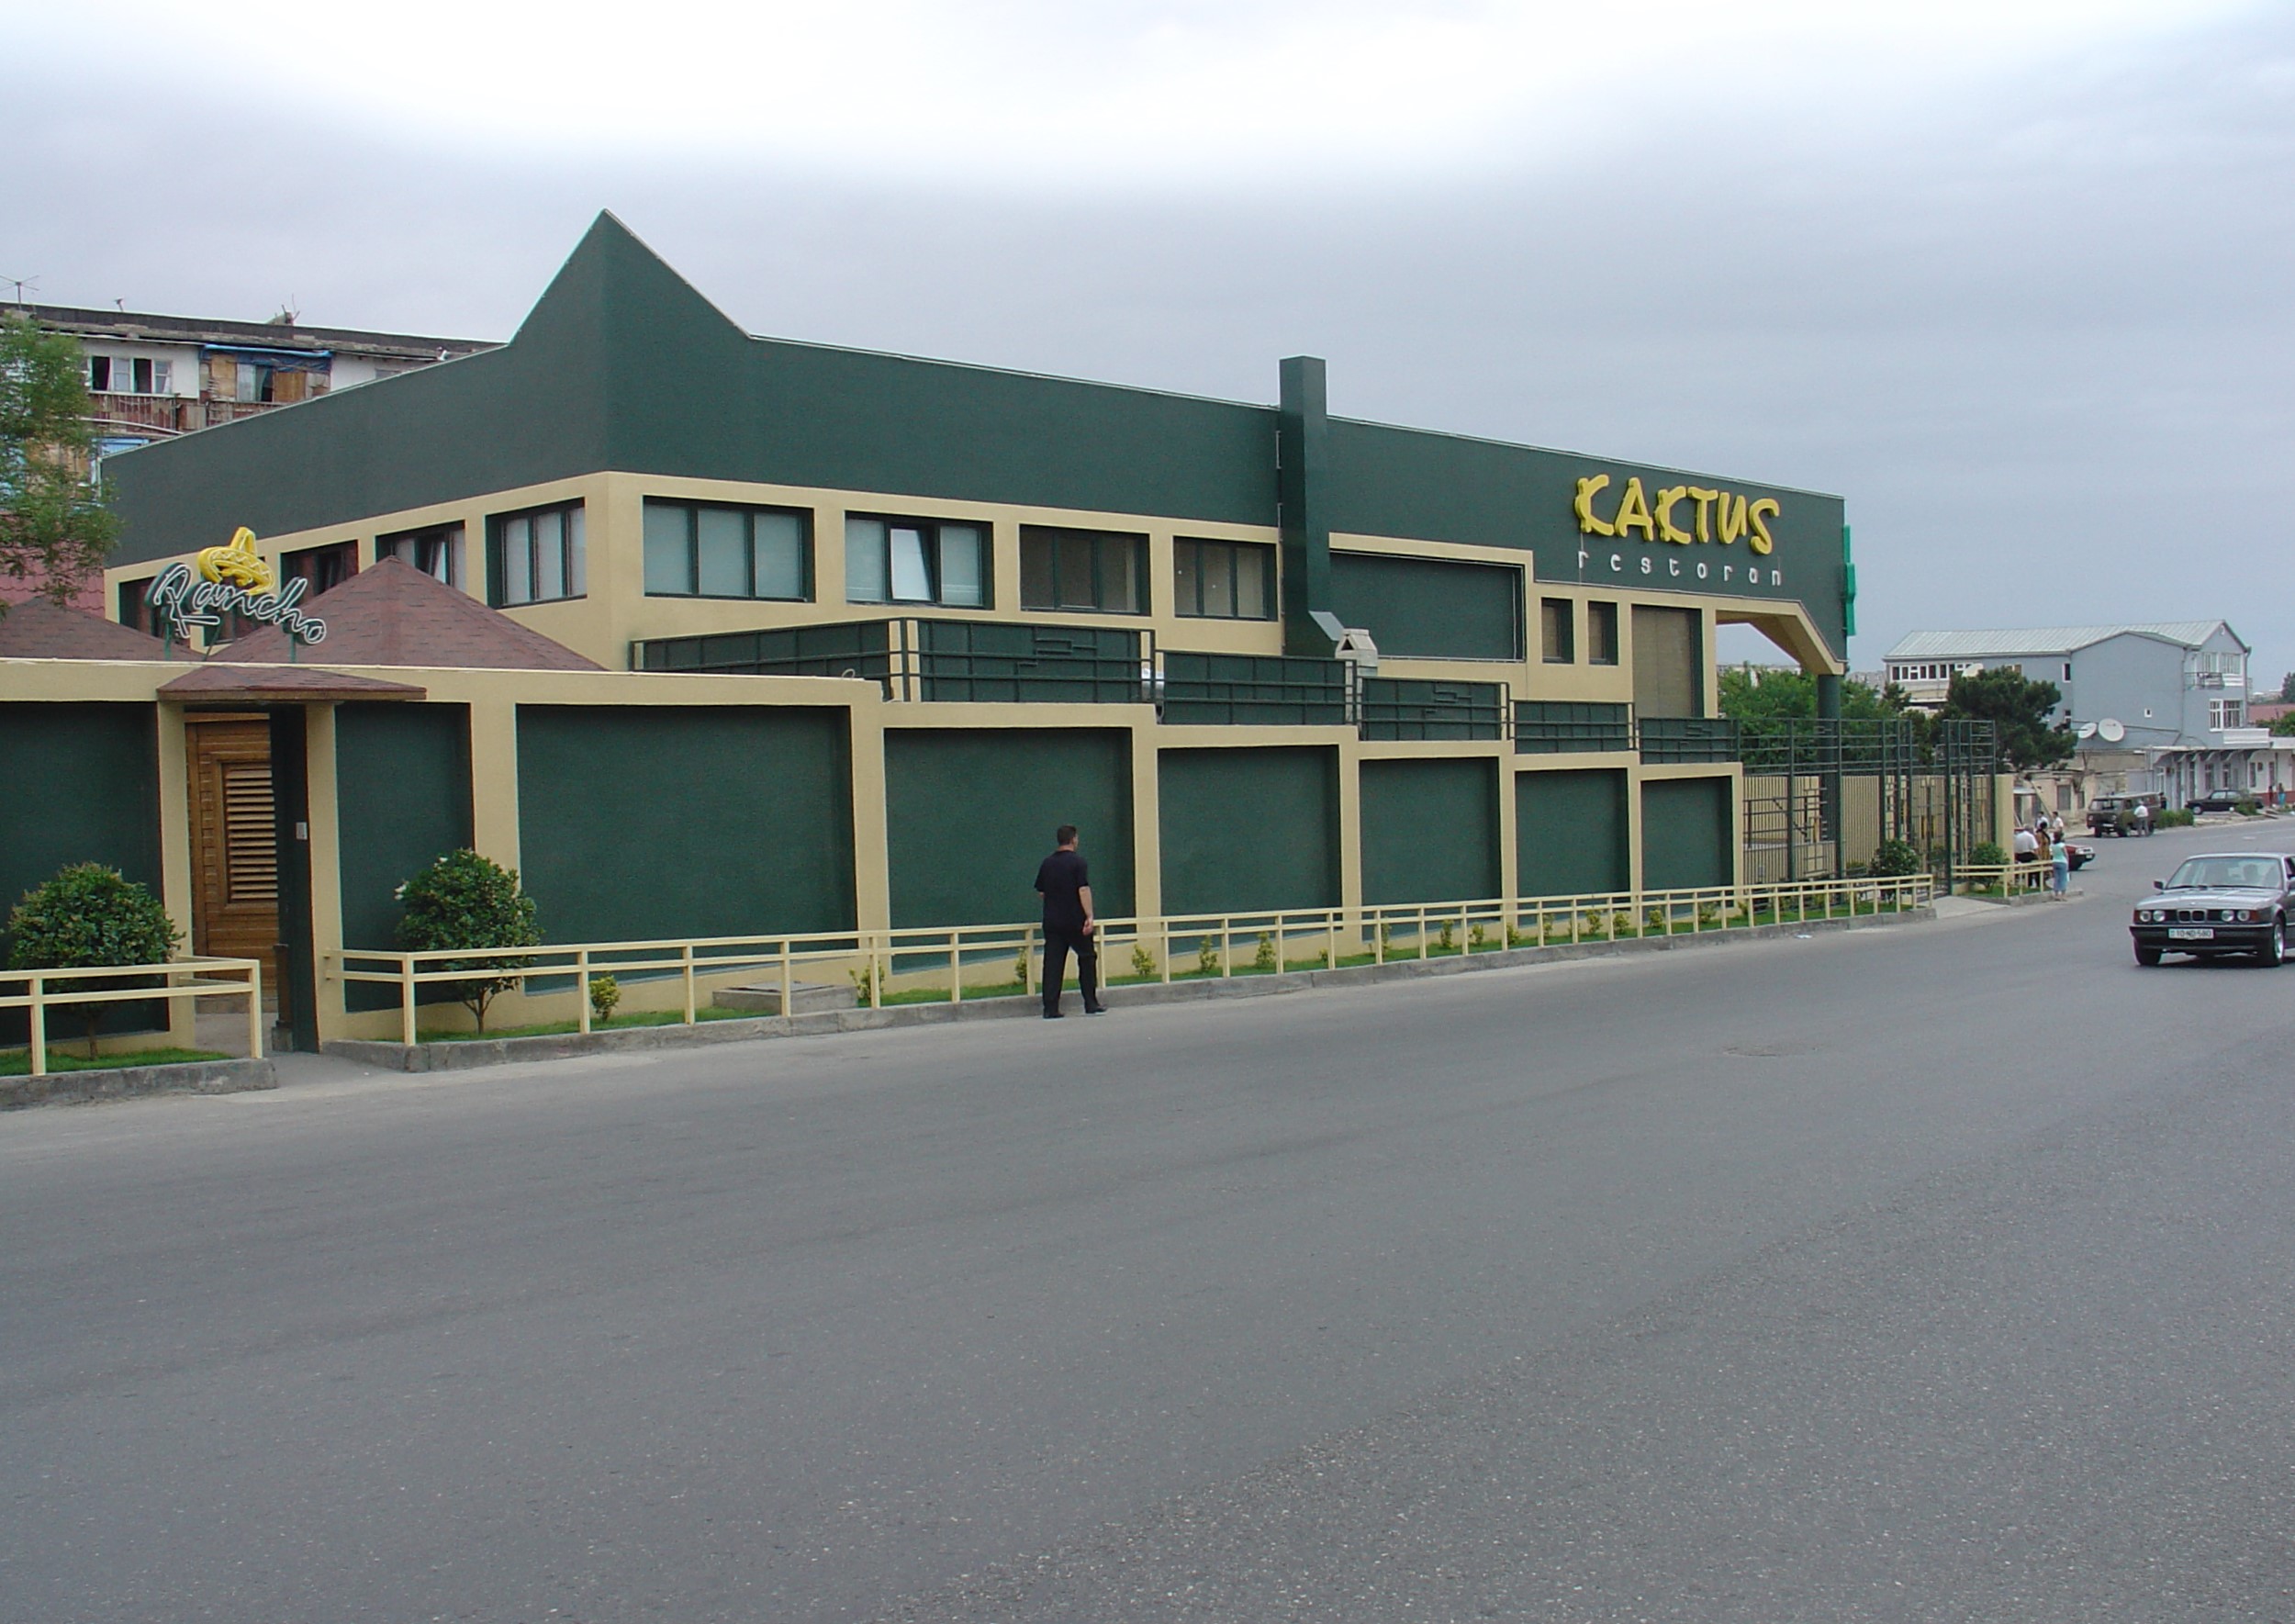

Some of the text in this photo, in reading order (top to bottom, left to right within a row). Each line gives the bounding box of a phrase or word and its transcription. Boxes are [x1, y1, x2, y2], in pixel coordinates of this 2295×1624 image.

[1574, 474, 1780, 555] CACTUS
[145, 563, 327, 644] Rancho
[1578, 551, 1782, 586] restoran
